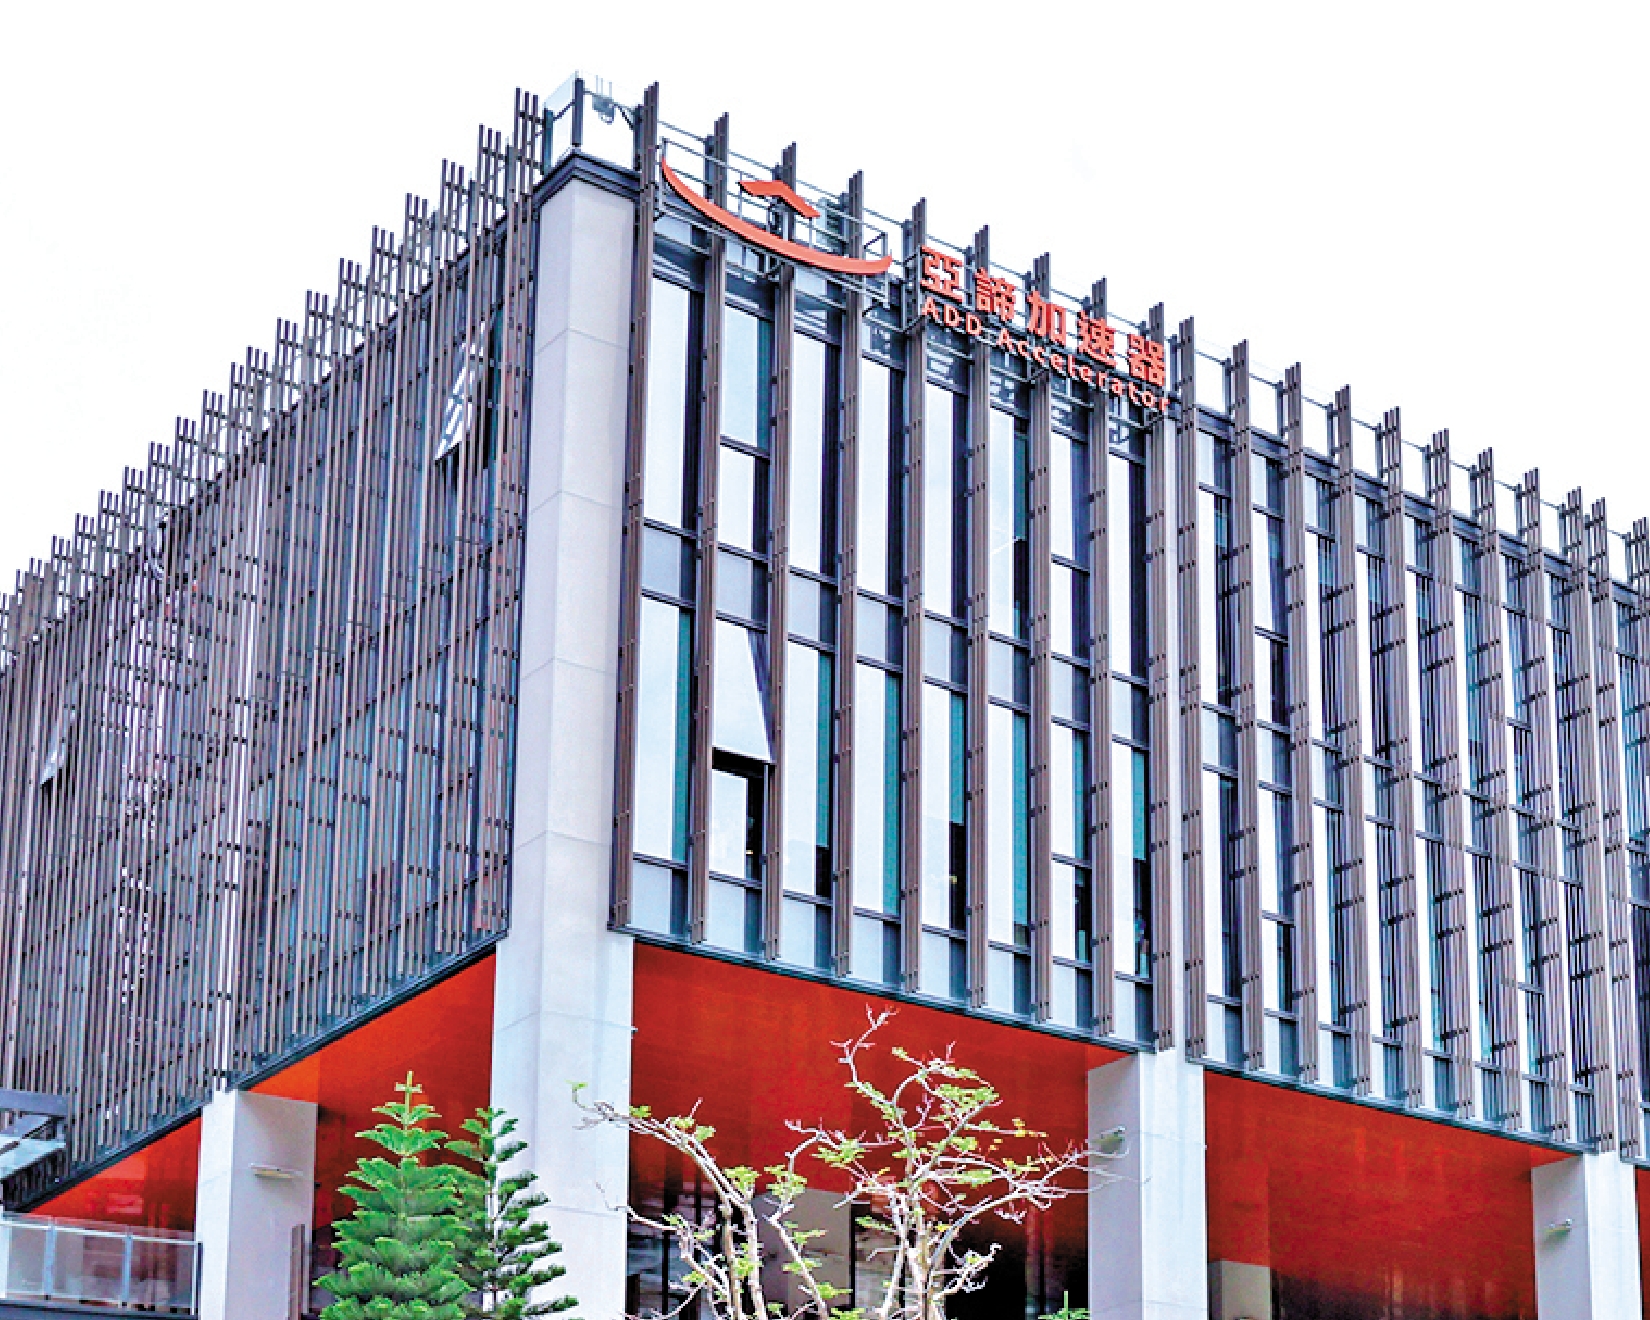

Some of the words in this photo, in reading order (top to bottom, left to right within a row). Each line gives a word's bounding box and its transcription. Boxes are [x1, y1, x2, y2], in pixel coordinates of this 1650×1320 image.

[920, 244, 1166, 387] 亞諦加速器
[996, 327, 1170, 413] Accelerator
